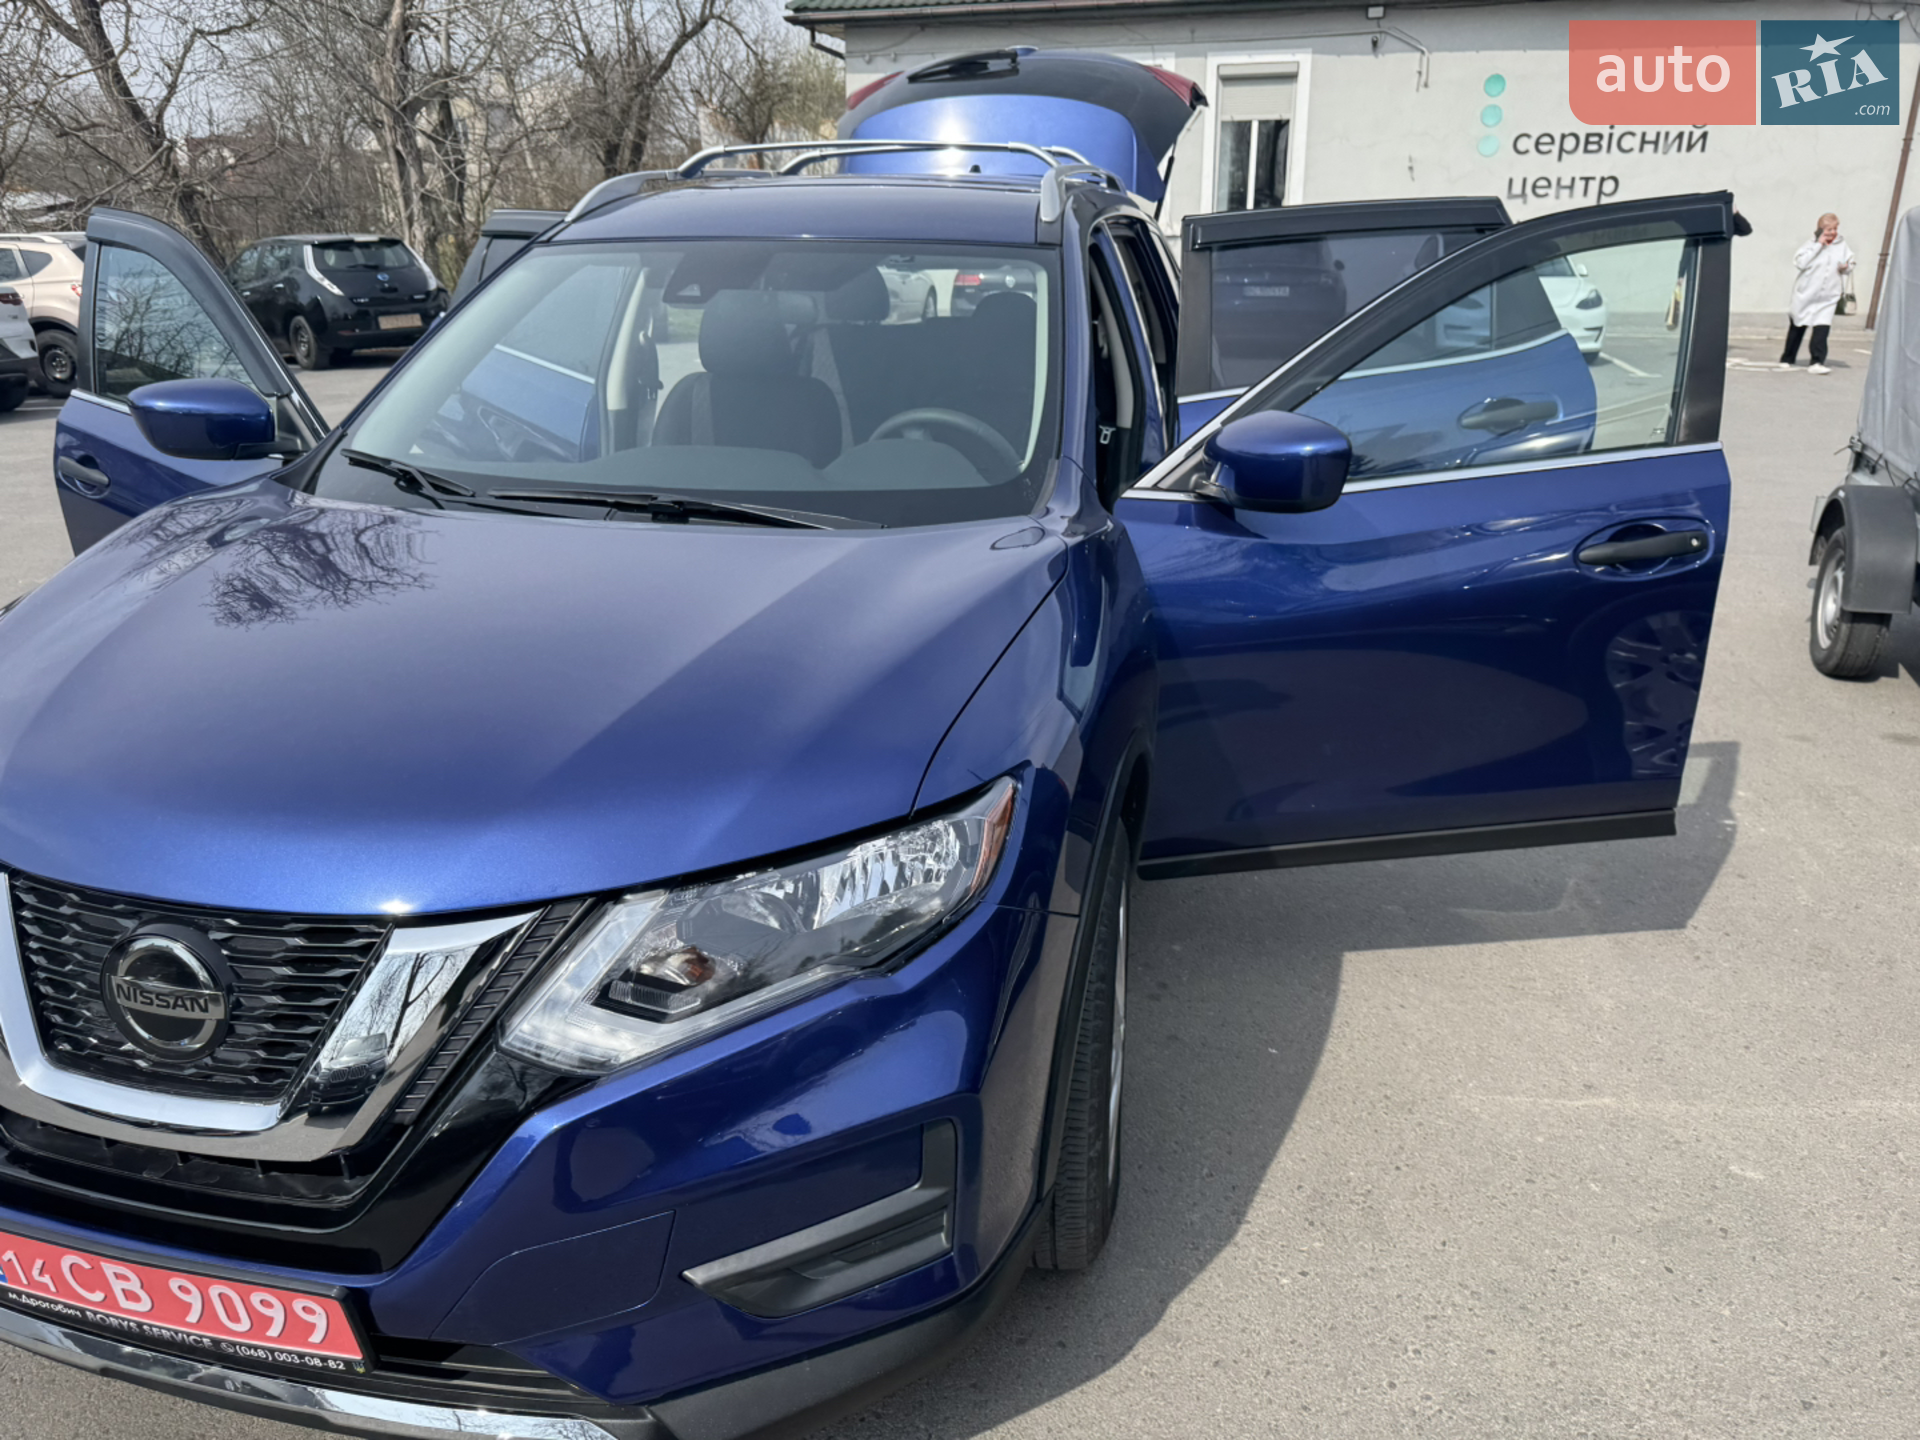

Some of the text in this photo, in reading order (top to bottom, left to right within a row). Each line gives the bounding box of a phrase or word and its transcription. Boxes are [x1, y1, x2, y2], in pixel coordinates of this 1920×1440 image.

[1512, 124, 1709, 162] сервісний
[1507, 175, 1620, 205] центр
[116, 983, 210, 1014] NISSAN
[168, 1277, 329, 1344] 9099
[85, 1310, 139, 1333] BORYS
[142, 1324, 214, 1350] SERVICE
[236, 1344, 272, 1361] (068)
[274, 1351, 346, 1370] 003-08-82
